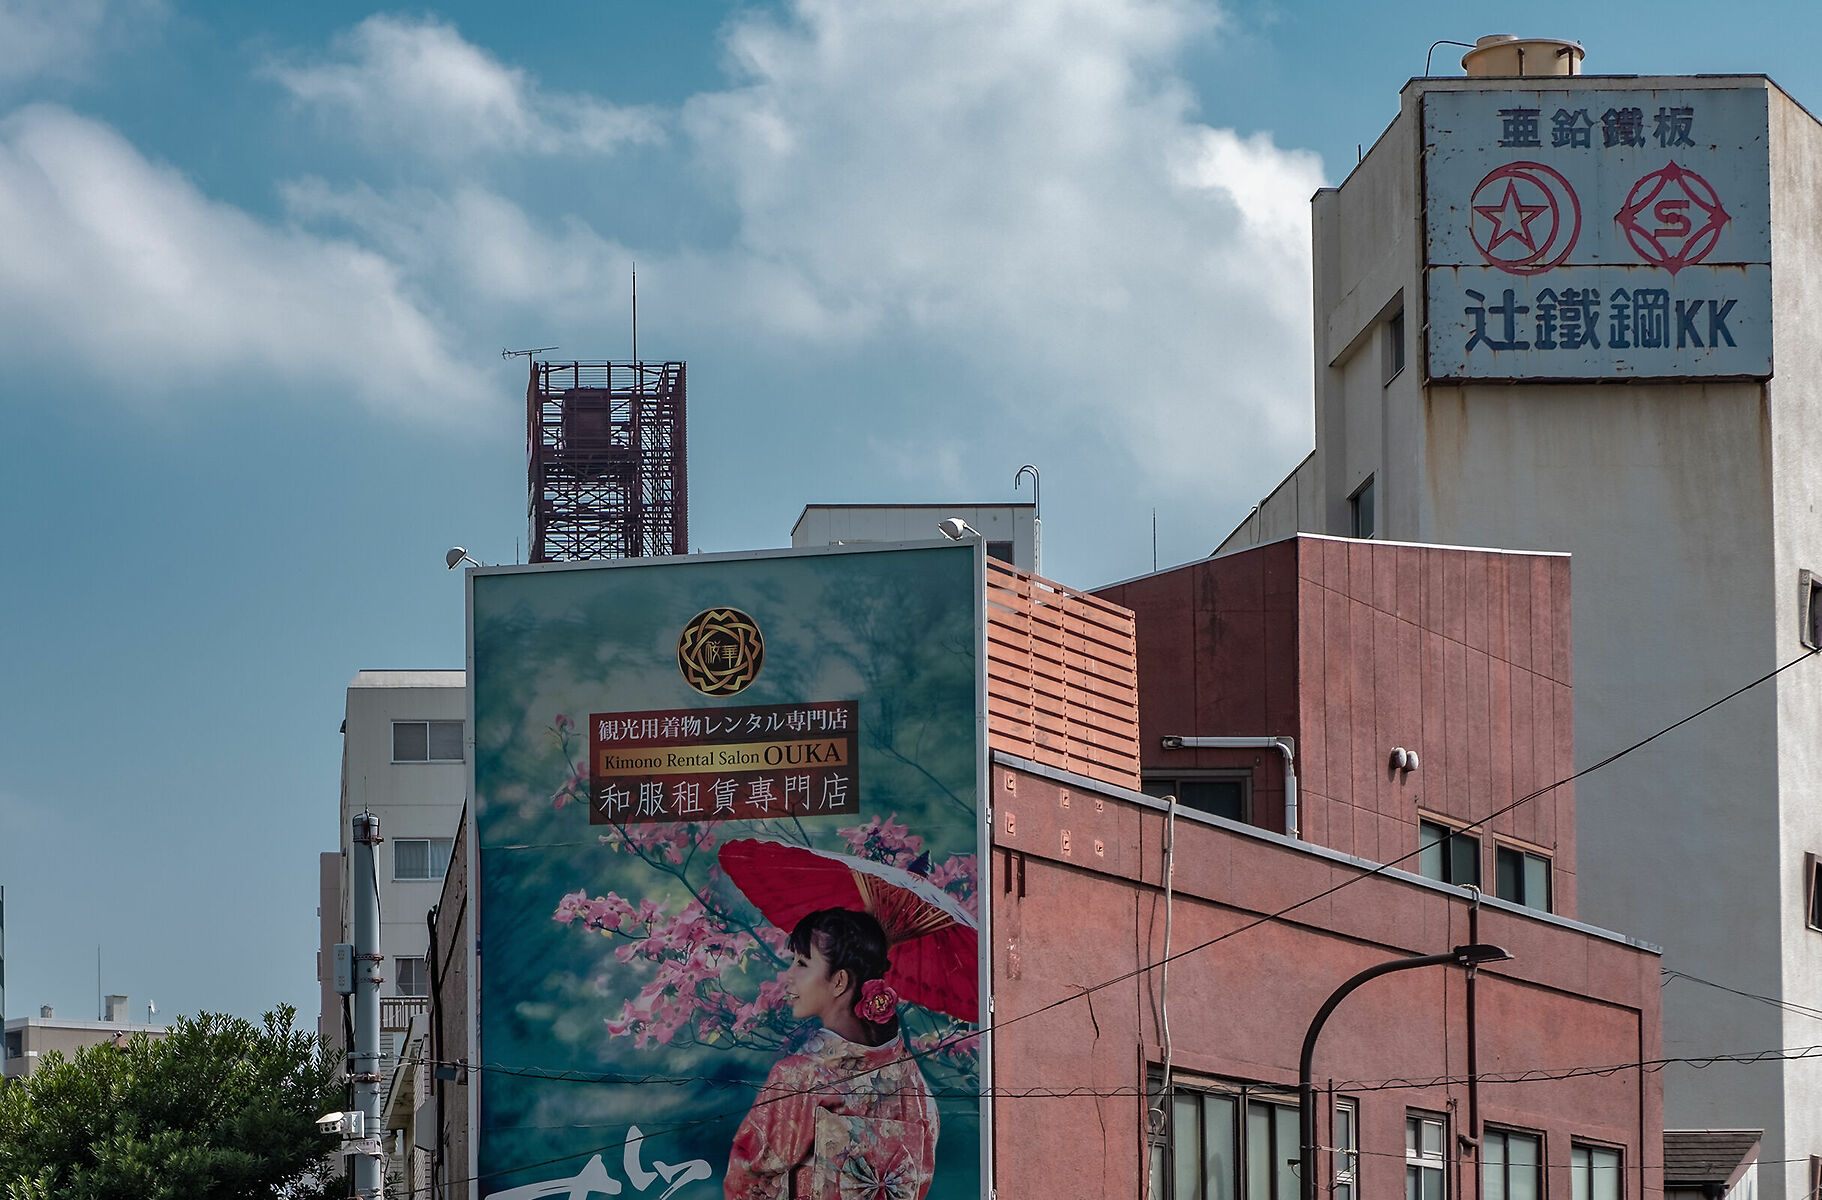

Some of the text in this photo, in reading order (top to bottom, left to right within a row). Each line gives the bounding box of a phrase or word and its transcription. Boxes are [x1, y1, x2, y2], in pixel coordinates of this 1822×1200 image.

[1498, 106, 1696, 149] 亜鉛鐵板
[598, 708, 849, 742] 観光用着物レンタル専門店
[604, 742, 843, 770] Kimono Rental Salon OUKA
[599, 772, 849, 819] 和服租賃專門店
